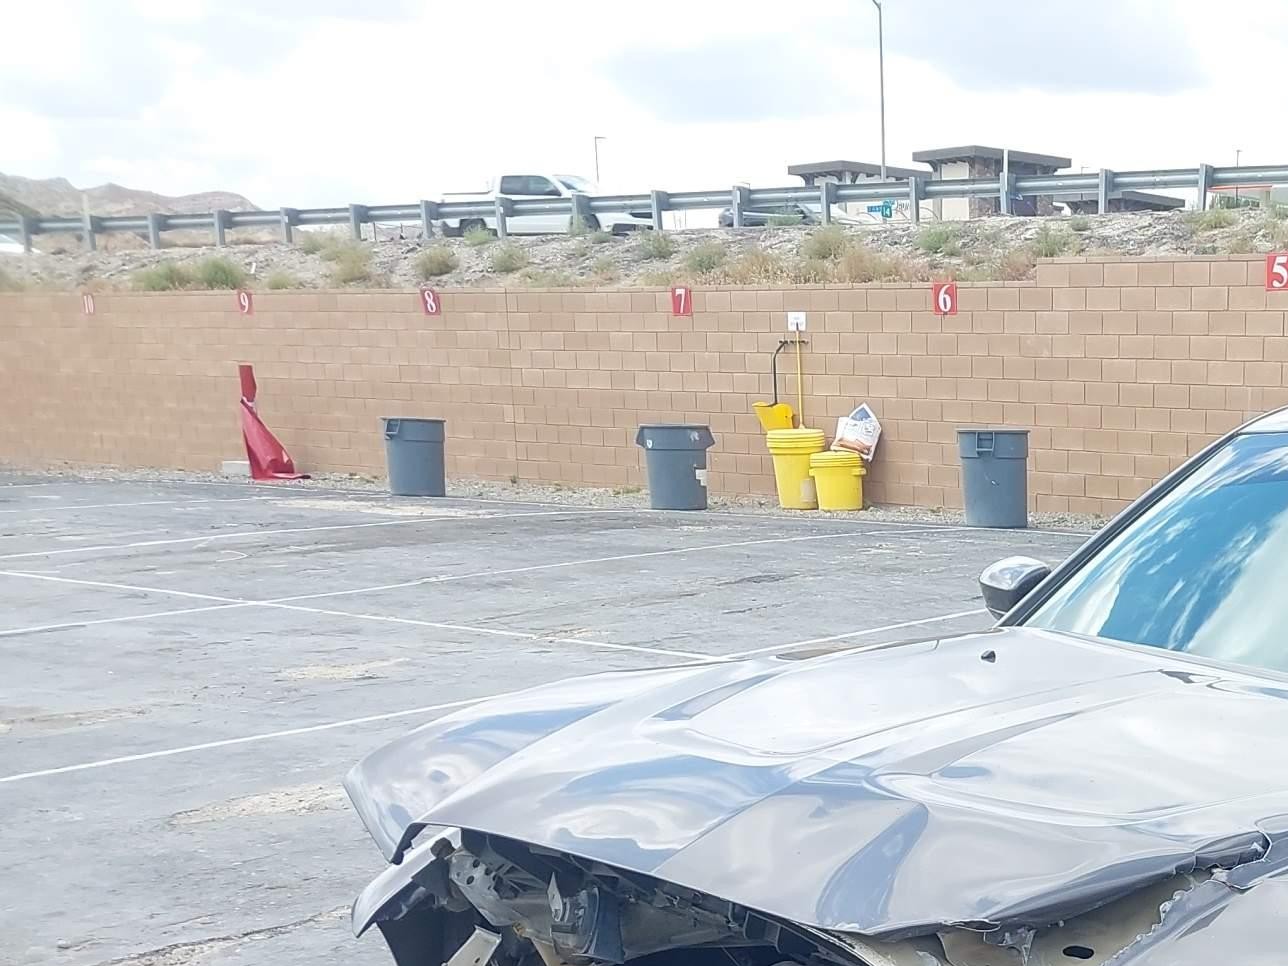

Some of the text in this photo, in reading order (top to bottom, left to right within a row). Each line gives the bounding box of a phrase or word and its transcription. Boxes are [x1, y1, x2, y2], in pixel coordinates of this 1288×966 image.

[1272, 255, 1288, 288] 5
[83, 294, 94, 314] 10
[240, 292, 249, 313] 9
[424, 290, 437, 313] 8
[675, 288, 686, 314] 7
[938, 284, 952, 312] 6
